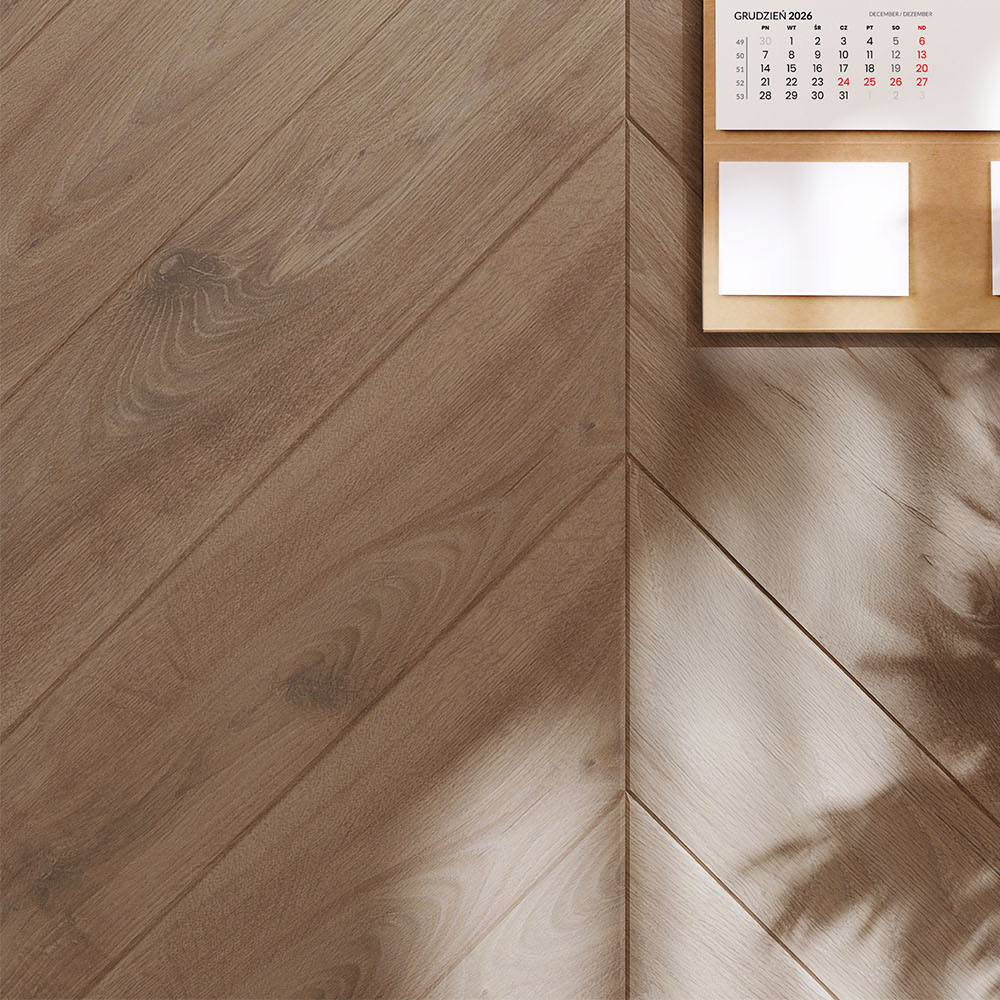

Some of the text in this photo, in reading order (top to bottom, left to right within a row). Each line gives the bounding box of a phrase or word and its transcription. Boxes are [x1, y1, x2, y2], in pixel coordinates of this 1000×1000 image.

[734, 10, 813, 20] GRUDZIEŃ 2026
[790, 37, 793, 45] 1
[815, 37, 820, 45] 2
[841, 37, 846, 45] 3
[867, 37, 873, 45] 4
[893, 37, 899, 45] 5
[919, 37, 925, 45] 6
[763, 50, 768, 59] 7
[789, 50, 795, 59] 8
[815, 50, 821, 59] 9
[839, 50, 848, 59] 10
[867, 50, 873, 59] 11
[892, 50, 900, 59] 12
[917, 50, 927, 59] 13
[761, 64, 770, 72] 14
[787, 64, 796, 72] 15
[813, 64, 822, 72] 16
[839, 64, 848, 72] 17
[865, 64, 874, 73] 18
[891, 64, 901, 72] 19
[916, 64, 928, 72] 20
[761, 77, 769, 86] 21
[786, 77, 797, 86] 22
[812, 77, 823, 86] 23
[838, 77, 850, 86] 24
[864, 77, 876, 86] 25
[890, 77, 902, 86] 26
[916, 77, 928, 86] 27
[760, 91, 771, 100] 28
[785, 91, 797, 100] 29
[811, 91, 824, 100] 30
[839, 91, 848, 100] 31
